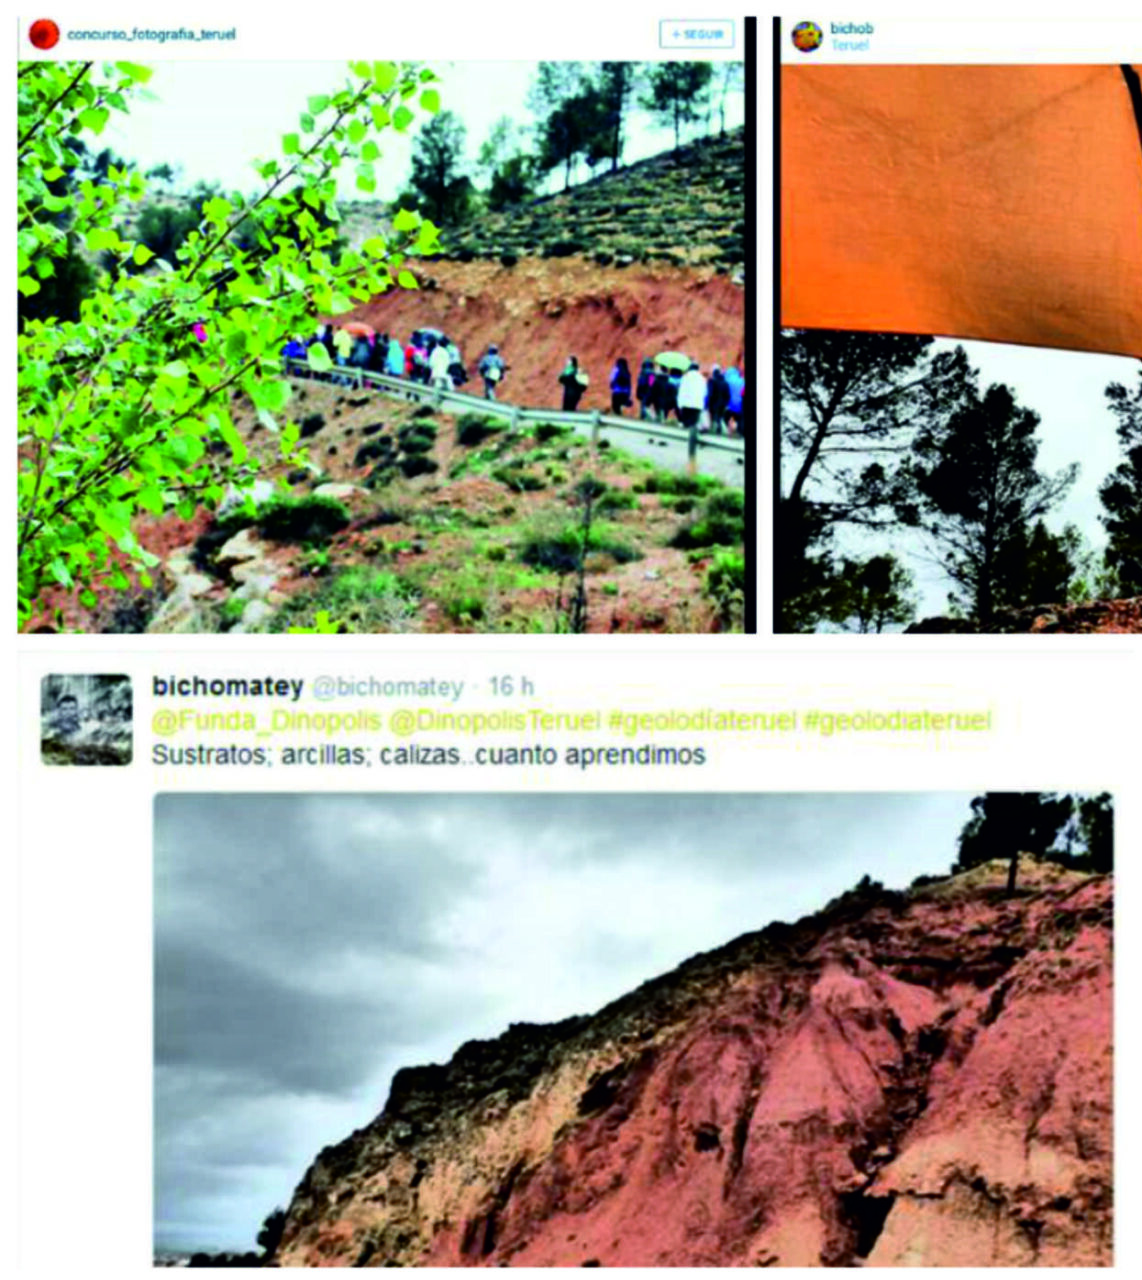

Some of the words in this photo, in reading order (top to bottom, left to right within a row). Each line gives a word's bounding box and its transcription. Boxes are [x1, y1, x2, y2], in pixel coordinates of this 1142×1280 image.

[67, 27, 236, 43] concurso_fotografia_teruel
[684, 29, 725, 39] SEGUIR
[830, 22, 874, 34] bichob
[832, 39, 869, 51] Teruel
[152, 676, 303, 701] bichomatey
[312, 675, 464, 701] @bichomatey
[489, 676, 514, 696] 16
[522, 676, 534, 695] h
[152, 709, 383, 736] @Funda_Dinopolis
[390, 709, 601, 736] @DinopolisTeruel
[152, 744, 272, 767] Sustratos;
[281, 744, 371, 766] arcillas;
[565, 744, 706, 770] aprendimos
